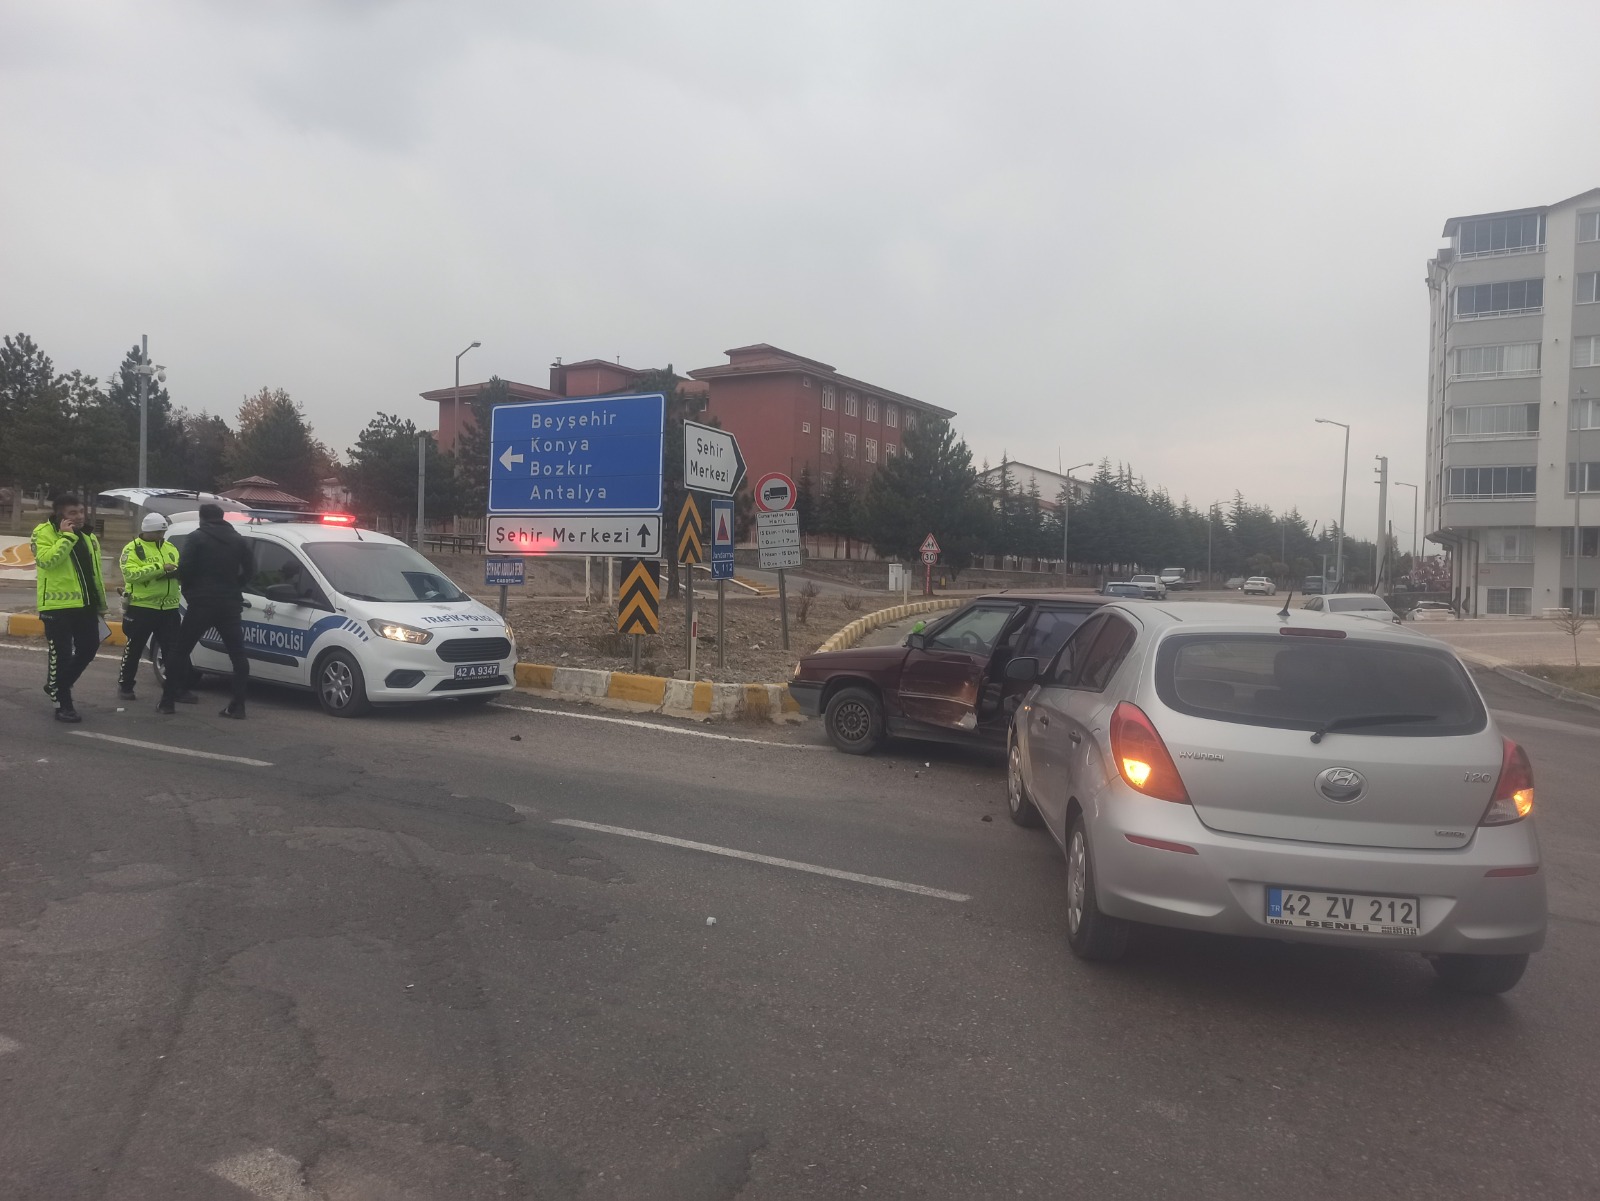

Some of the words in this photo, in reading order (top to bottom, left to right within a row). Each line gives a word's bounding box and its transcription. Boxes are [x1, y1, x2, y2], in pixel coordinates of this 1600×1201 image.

[531, 409, 617, 430] Beyşehir
[531, 437, 589, 455] Konya
[696, 437, 724, 457] Şehir
[530, 461, 592, 476] Bozkır
[690, 461, 729, 482] Merkezi
[530, 485, 607, 503] Antalya
[496, 526, 543, 544] Şehir
[552, 527, 630, 544] Merkezi
[924, 553, 936, 561] 30
[722, 563, 733, 572] 112
[241, 625, 267, 645] AFİK
[269, 630, 304, 652] POLİSİ
[456, 668, 468, 677] 42
[469, 667, 476, 676] A
[477, 665, 498, 676] 9347
[1179, 751, 1225, 762] HYUNDAI
[1270, 904, 1281, 912] TR
[1283, 894, 1311, 917] 42
[1326, 896, 1354, 920] ZV
[1370, 900, 1413, 924] 212
[1270, 918, 1294, 926] KONYA
